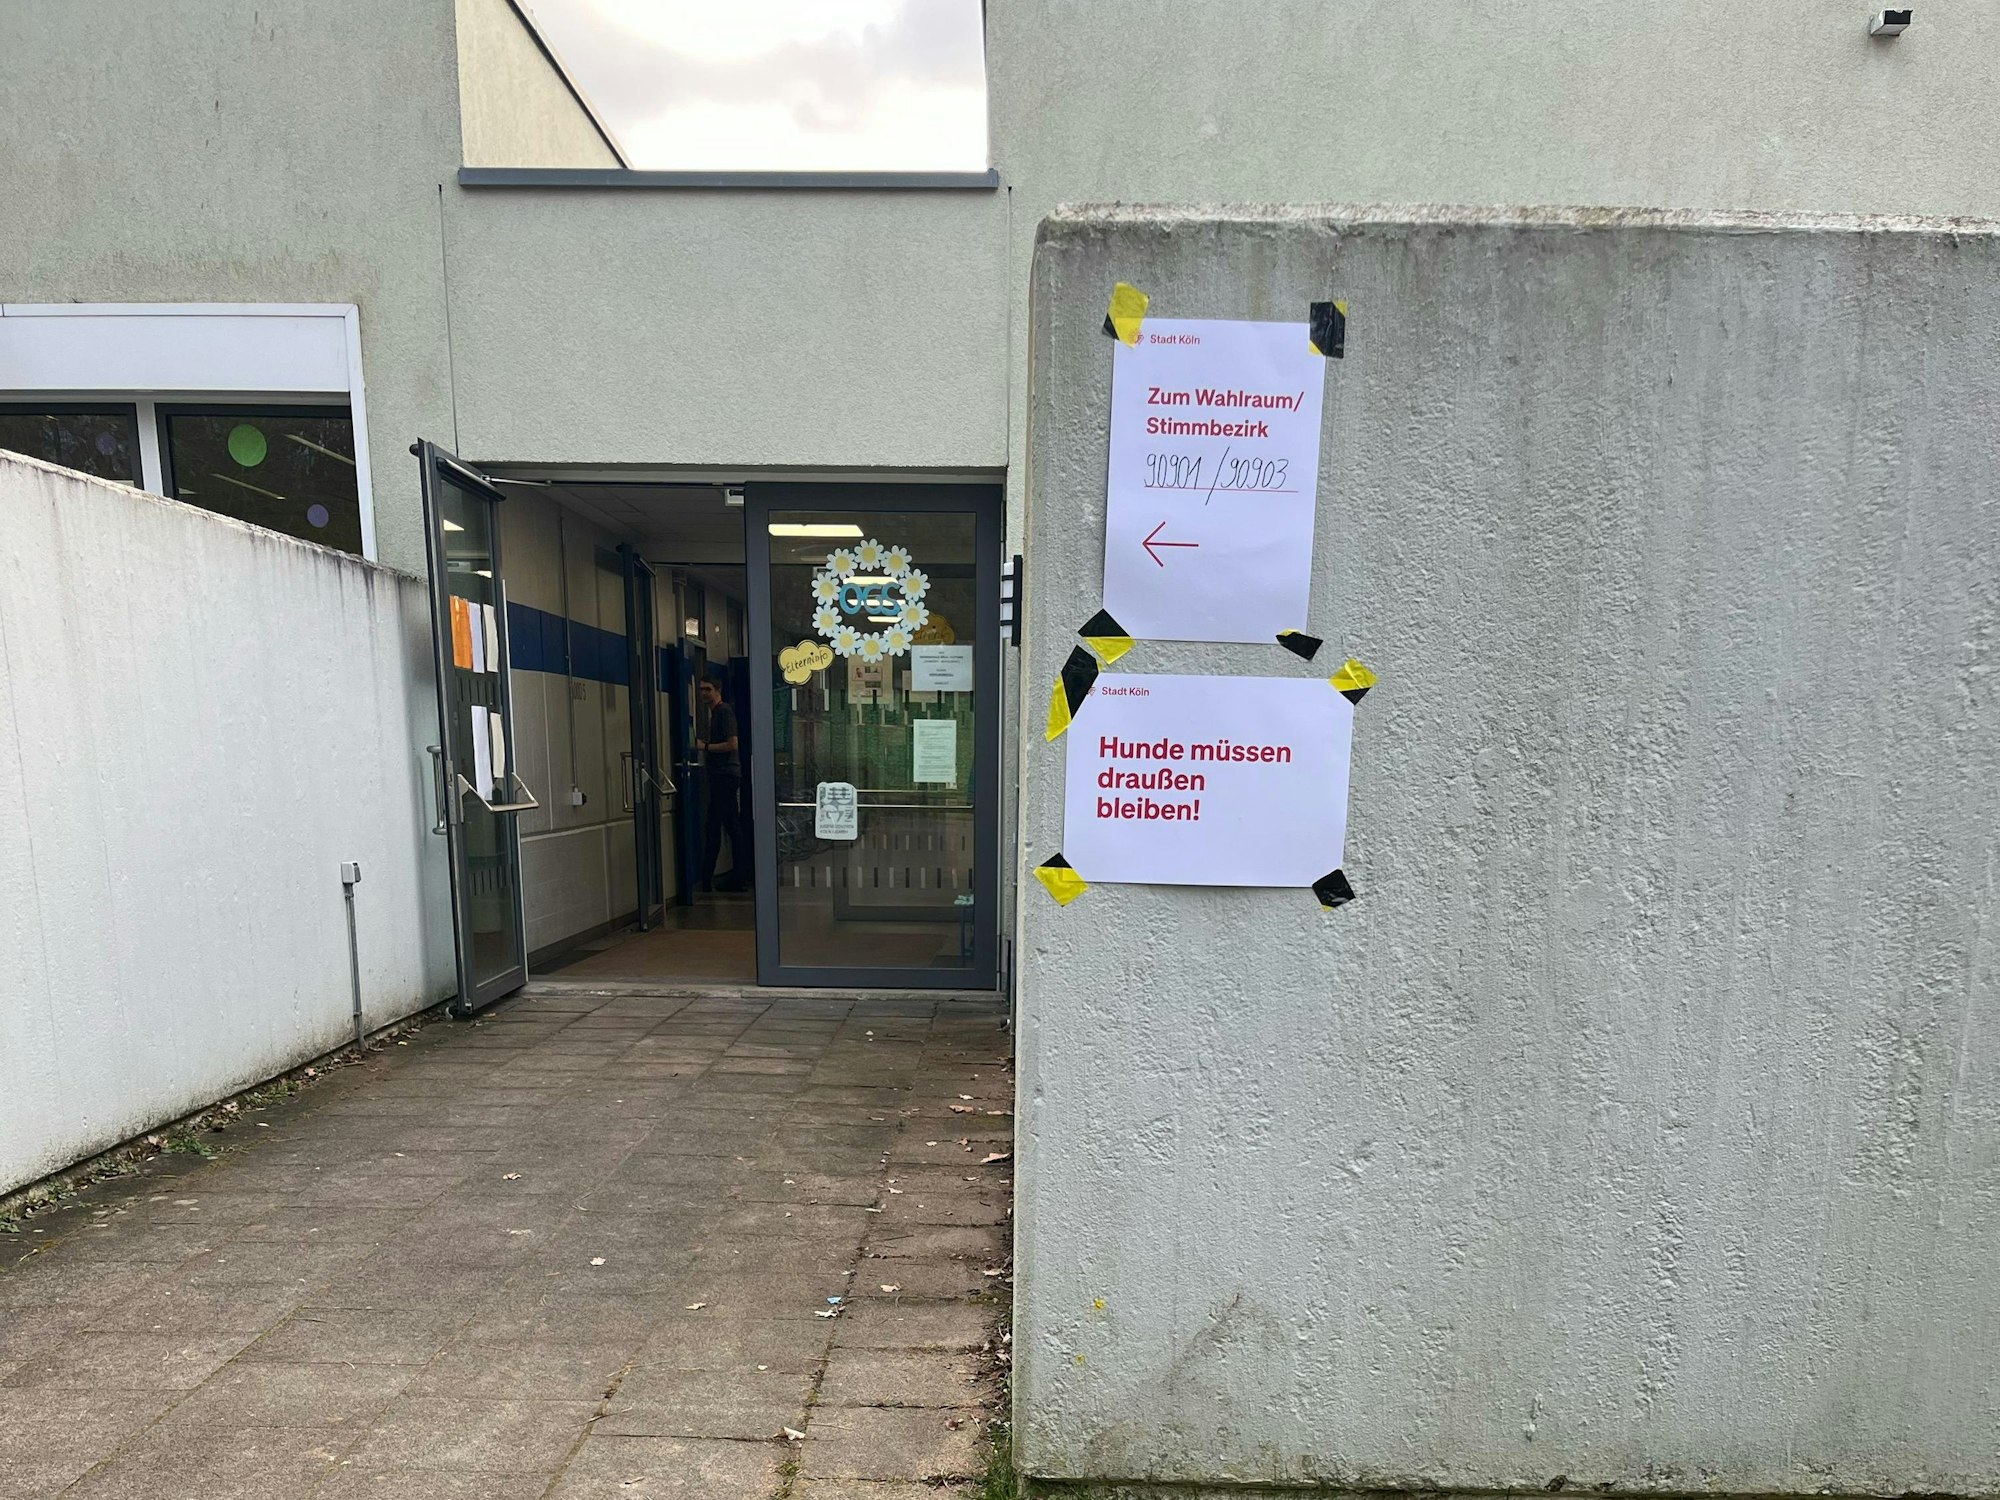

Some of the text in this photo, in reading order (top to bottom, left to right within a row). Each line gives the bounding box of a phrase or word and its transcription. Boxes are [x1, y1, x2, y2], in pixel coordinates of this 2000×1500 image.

[1150, 334, 1201, 345] Stadt Köln
[1147, 387, 1305, 412] Zum Wahlraum/
[1146, 417, 1269, 438] Stimmbezirk
[839, 581, 902, 616] OGS
[786, 650, 829, 674] Elterninfo
[1101, 686, 1150, 697] Stadt Köln
[1099, 737, 1292, 763] Hunde müssen
[1097, 767, 1205, 791] draußen
[1096, 797, 1201, 821] bleiben!
